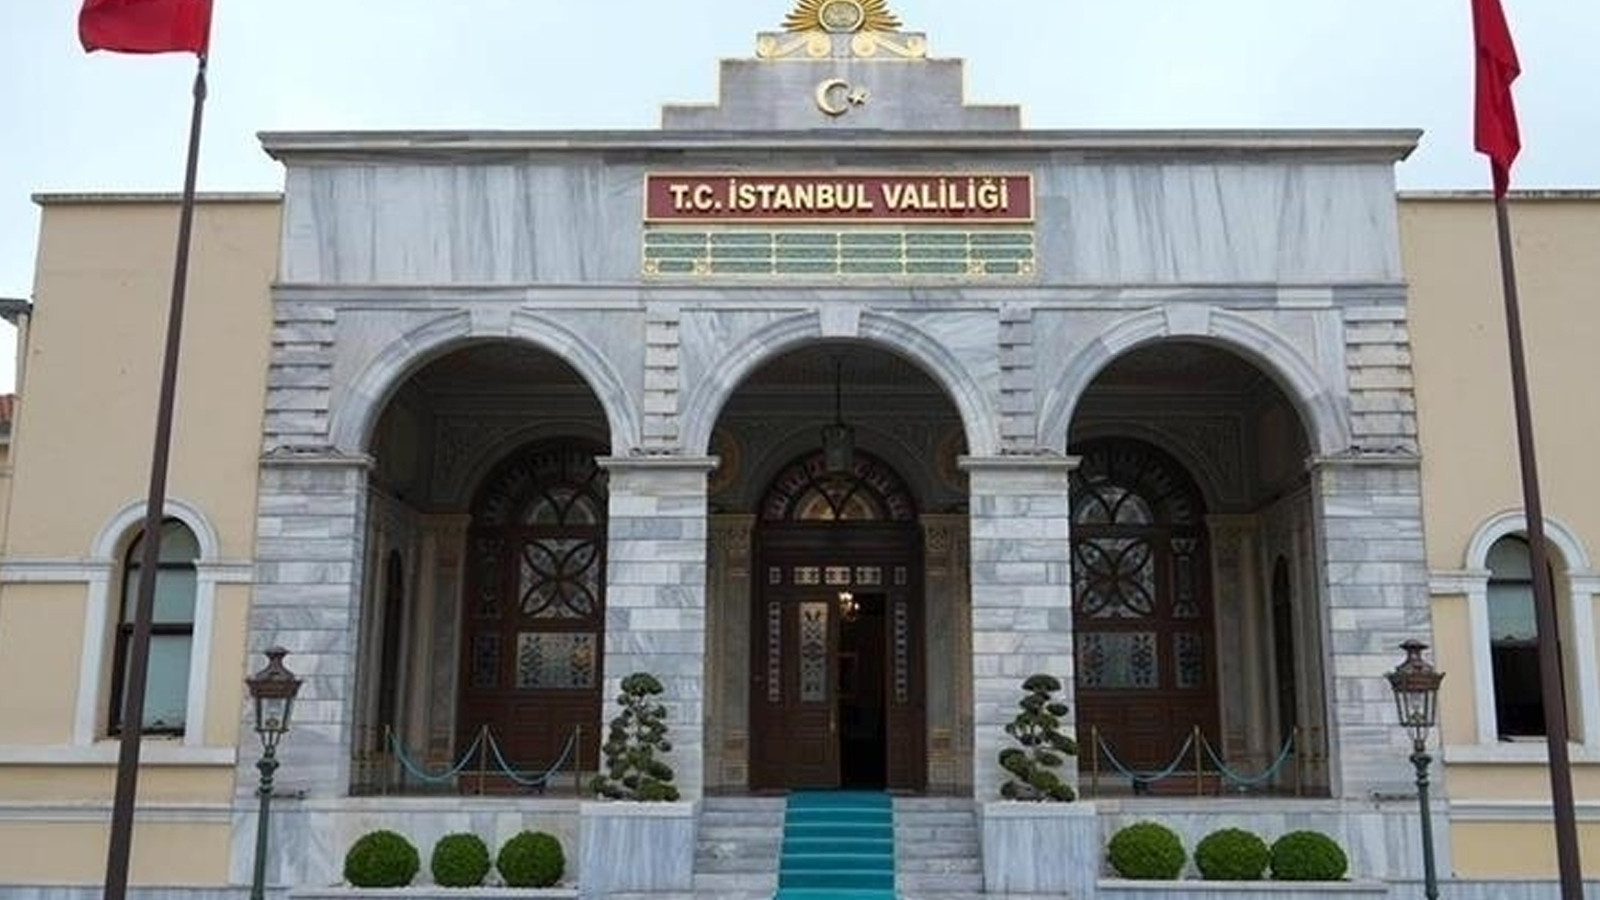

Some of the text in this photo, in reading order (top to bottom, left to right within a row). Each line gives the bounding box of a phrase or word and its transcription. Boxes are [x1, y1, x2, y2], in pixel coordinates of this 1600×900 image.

[670, 178, 1009, 210] T.C. İSTANBUL VALİLİĞİ
